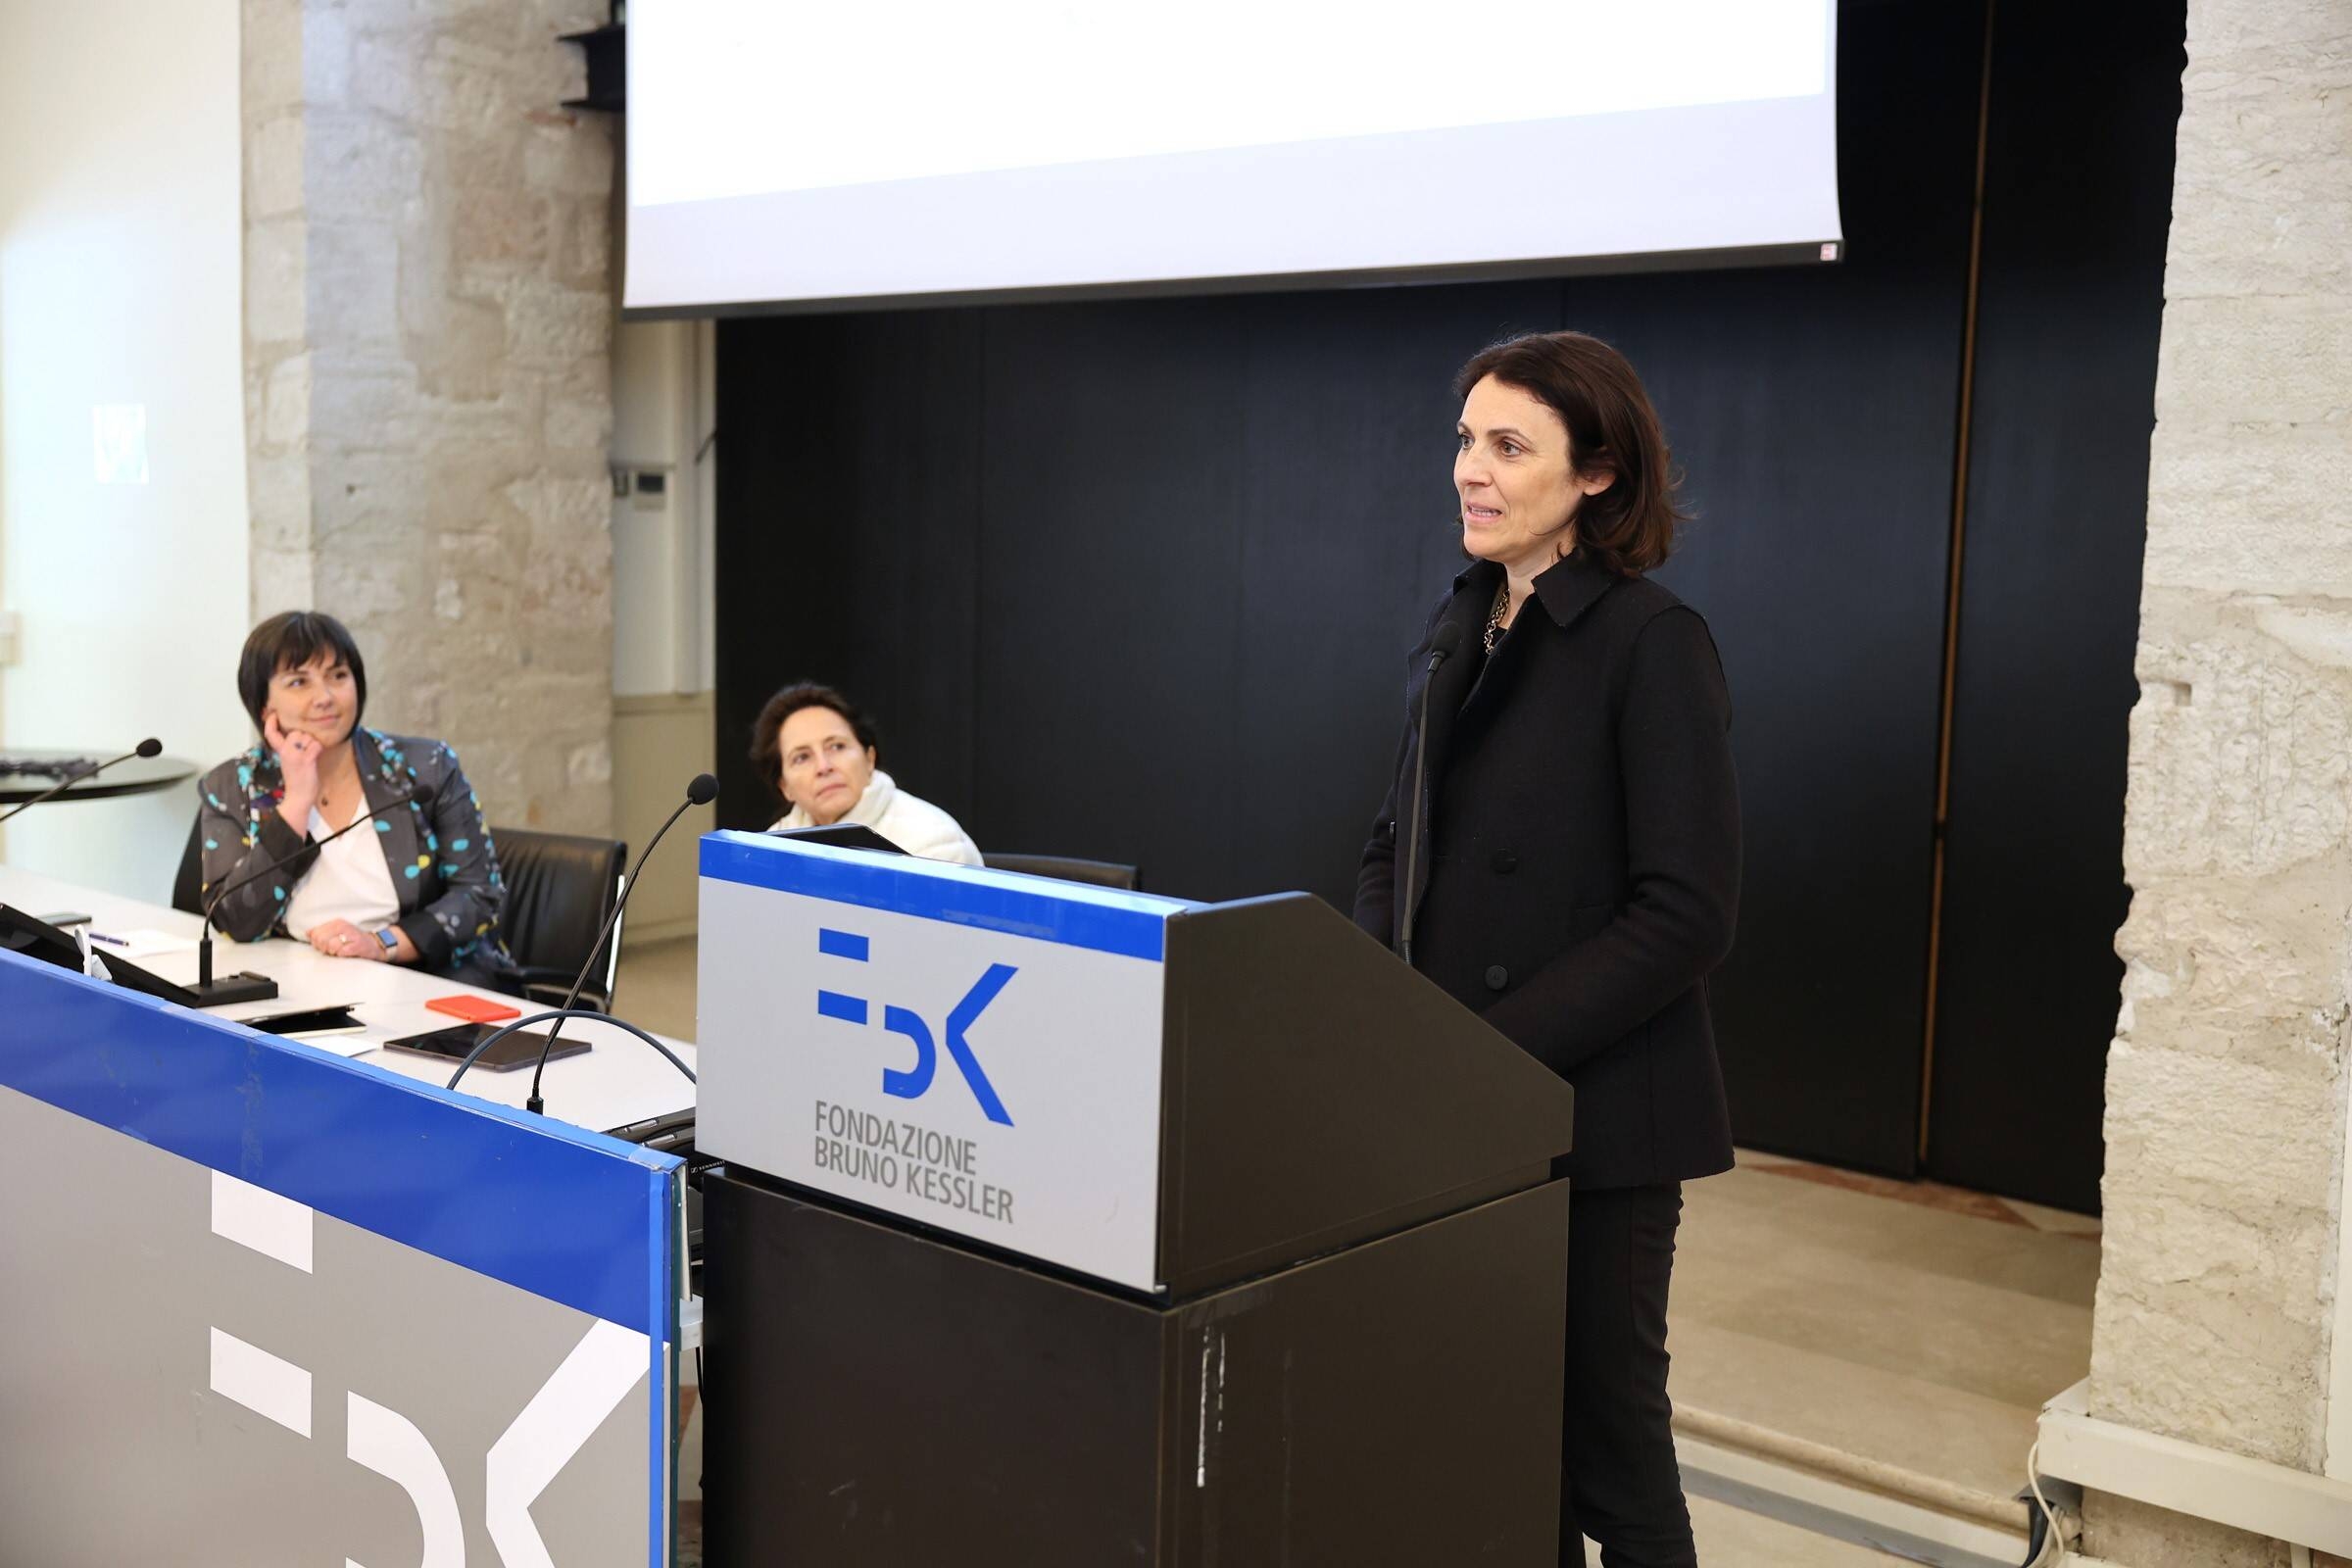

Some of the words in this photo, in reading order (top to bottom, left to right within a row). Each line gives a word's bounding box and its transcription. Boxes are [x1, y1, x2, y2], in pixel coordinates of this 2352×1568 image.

[815, 1100, 977, 1175] FONDAZIONE
[814, 1136, 898, 1189] BRUNO
[906, 1161, 1013, 1224] KESSLER
